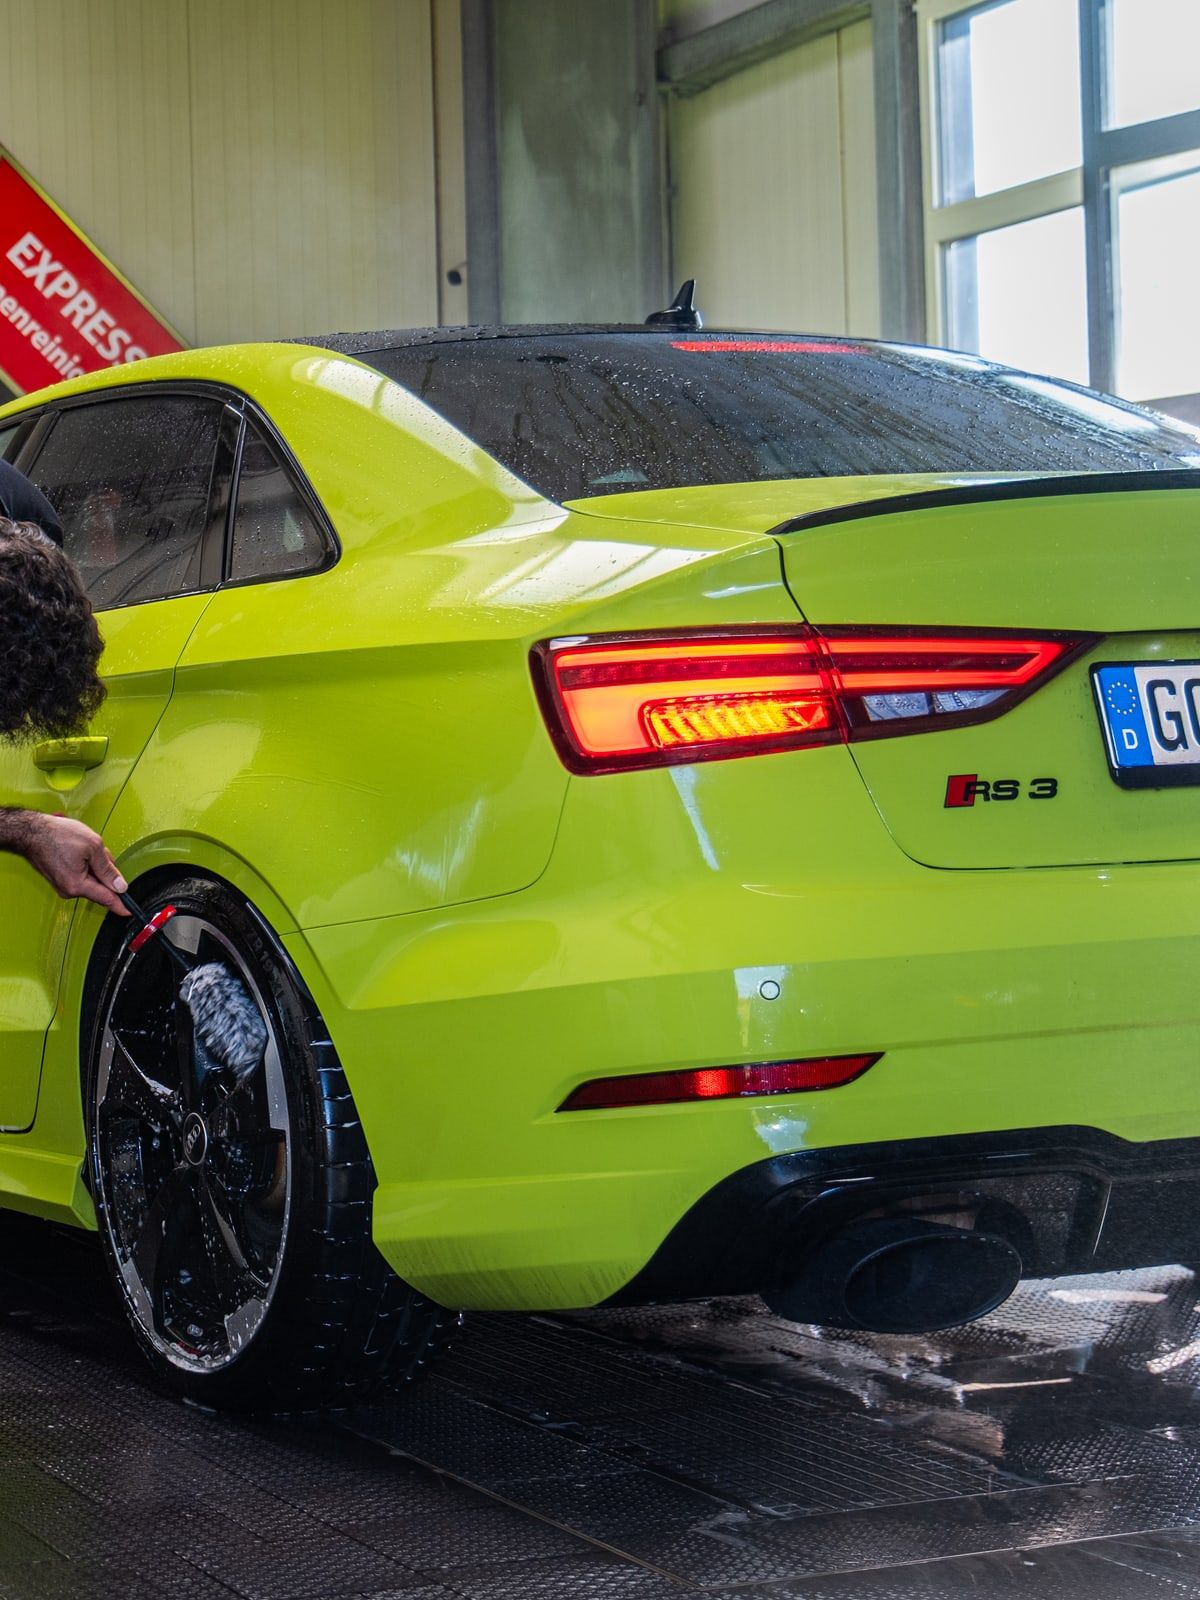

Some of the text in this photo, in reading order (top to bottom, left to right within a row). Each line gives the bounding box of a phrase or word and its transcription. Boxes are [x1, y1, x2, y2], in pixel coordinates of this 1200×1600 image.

[1122, 728, 1138, 749] D
[963, 778, 1058, 802] RS 3
